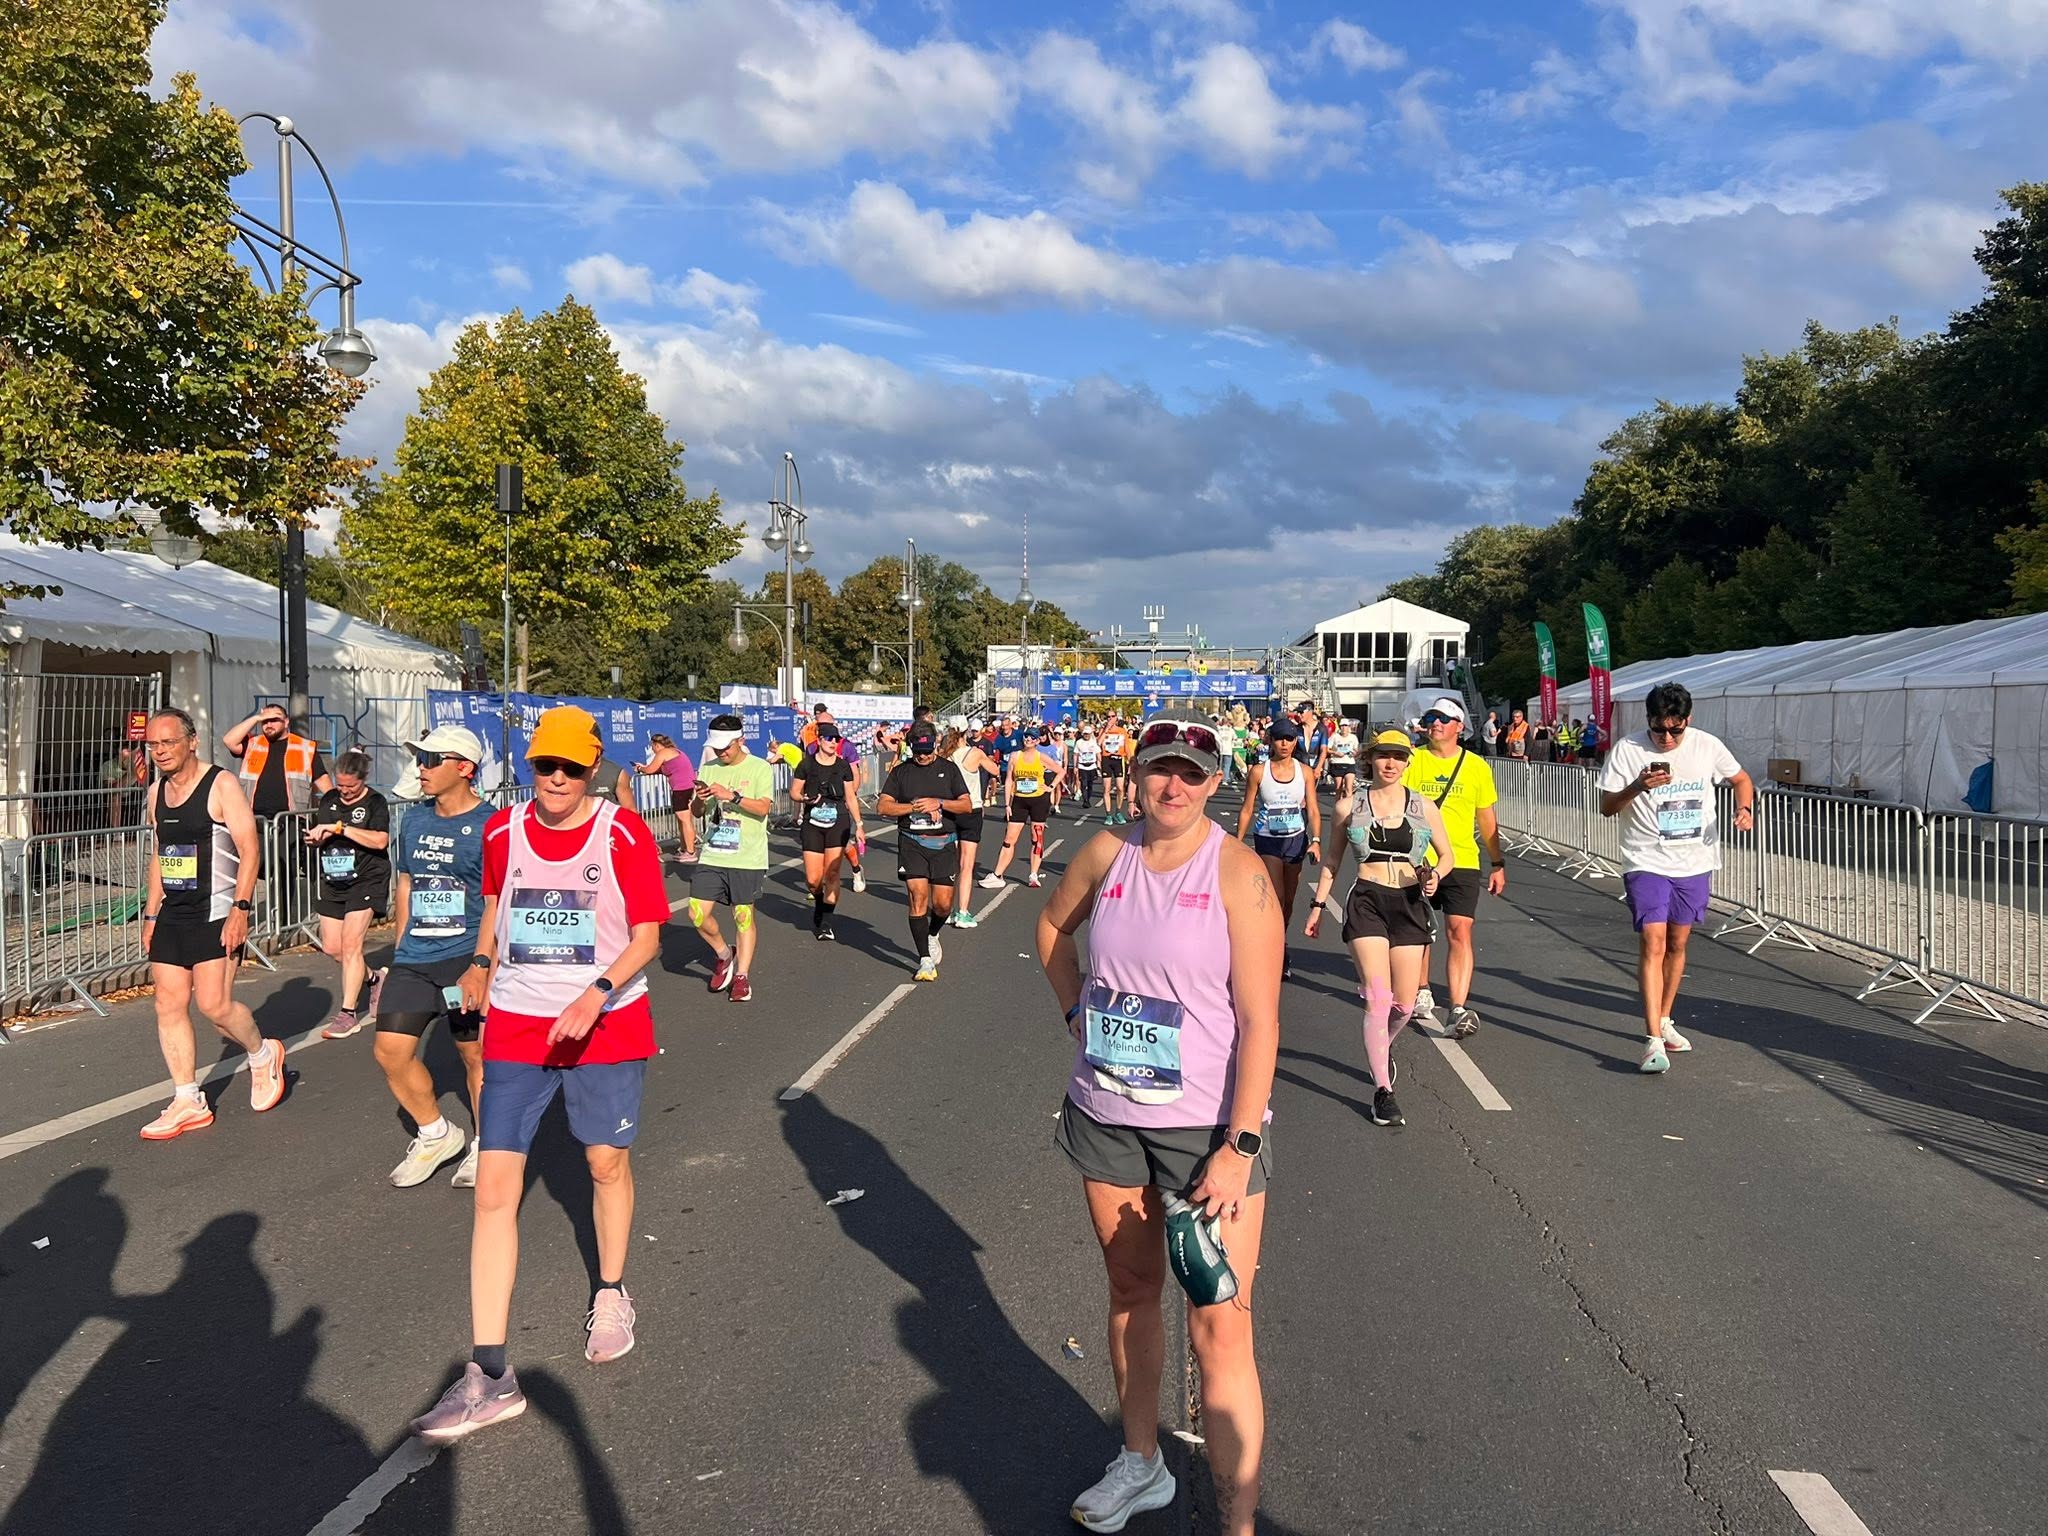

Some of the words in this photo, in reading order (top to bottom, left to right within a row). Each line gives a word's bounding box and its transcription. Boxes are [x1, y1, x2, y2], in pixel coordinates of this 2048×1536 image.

[435, 701, 454, 720] BMW
[611, 710, 625, 723] BMW
[612, 723, 626, 733] BERLIN
[612, 734, 635, 742] MARATHON
[1421, 784, 1445, 793] QUEEN
[1448, 785, 1464, 794] ITY
[1668, 811, 1695, 820] 73384
[418, 835, 455, 848] LESS
[412, 849, 455, 863] MORE
[419, 892, 452, 903] 16248
[525, 911, 580, 926] 64025
[542, 927, 563, 935] Nina
[528, 946, 575, 955] zalando
[1101, 1016, 1158, 1044] 87916
[1108, 1039, 1148, 1053] Melinda
[1177, 1231, 1190, 1276] NATHAN
